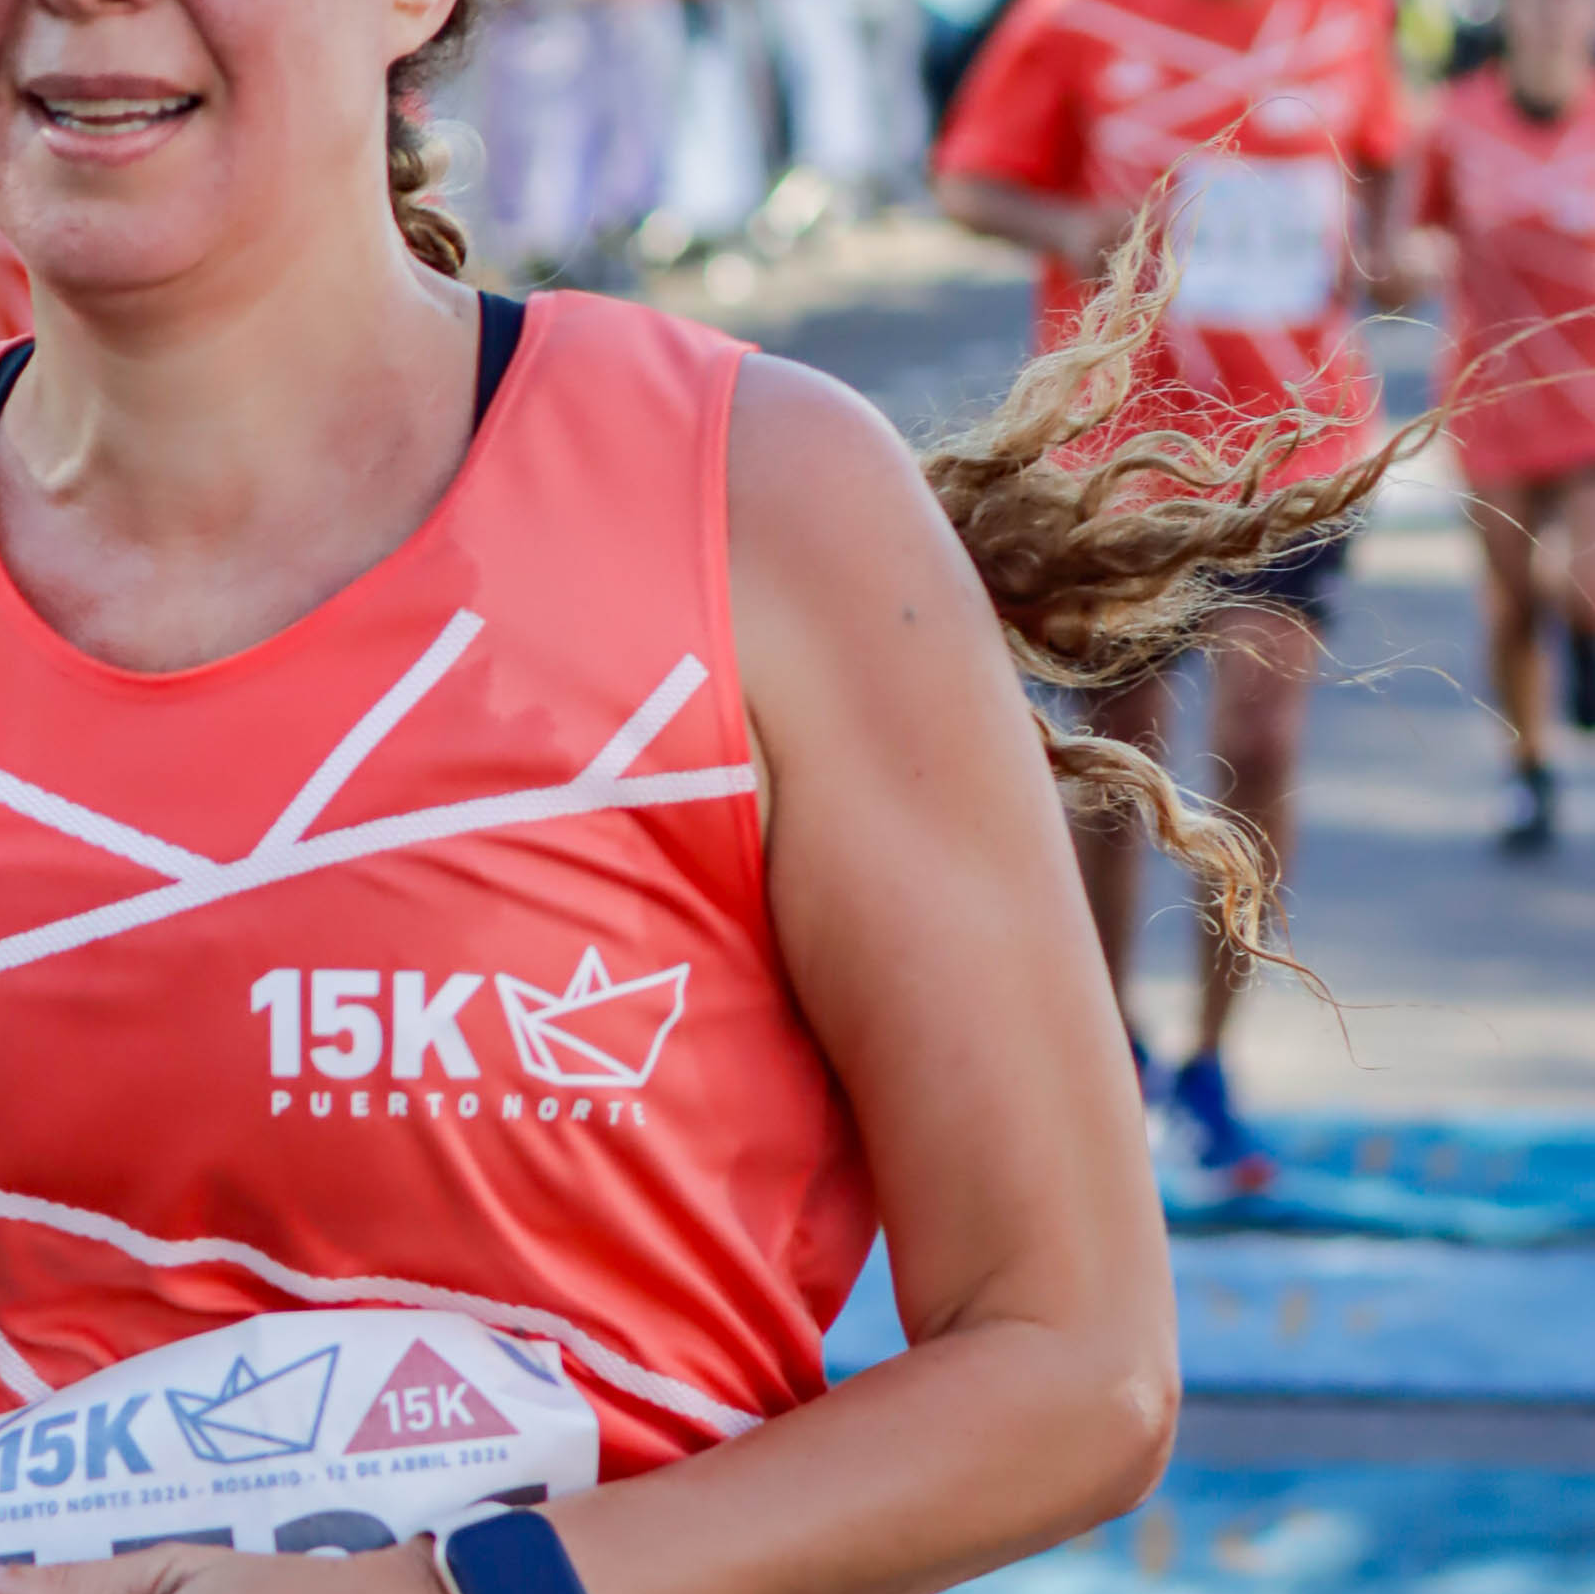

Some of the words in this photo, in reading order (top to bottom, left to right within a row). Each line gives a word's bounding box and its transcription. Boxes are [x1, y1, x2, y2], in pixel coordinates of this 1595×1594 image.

[250, 968, 485, 1080] 15K
[270, 1090, 480, 1119] PUERTO
[502, 1093, 646, 1126] NORTE
[380, 1381, 476, 1435] 15K
[65, 1489, 132, 1514] NORTE
[211, 1469, 303, 1495] ROSARIO
[326, 1463, 348, 1483] 12
[356, 1459, 382, 1478] DE
[390, 1452, 451, 1473] ABRIL
